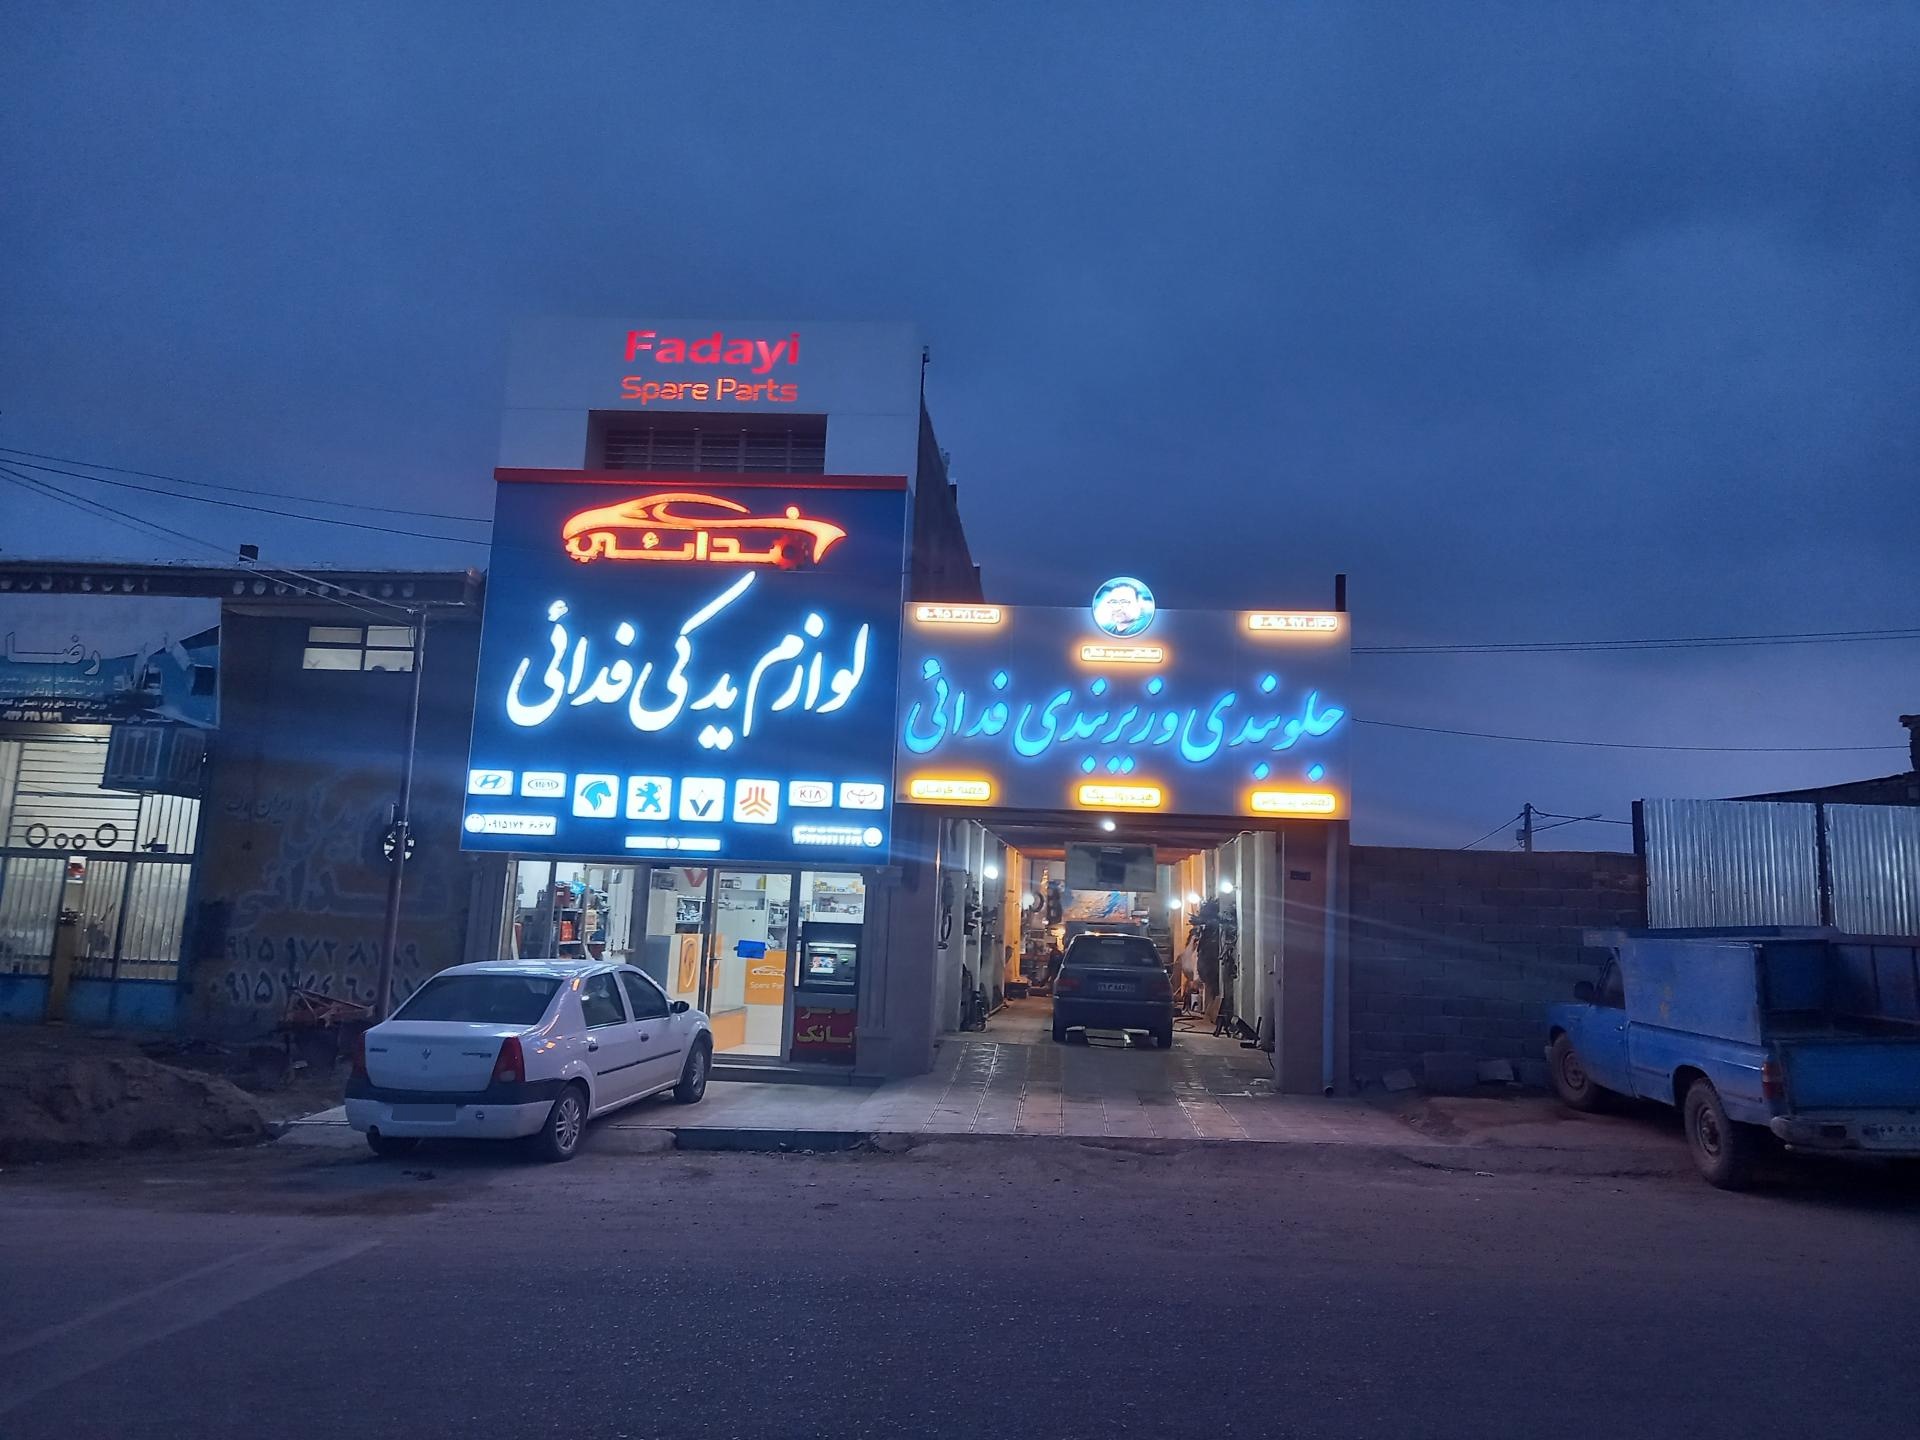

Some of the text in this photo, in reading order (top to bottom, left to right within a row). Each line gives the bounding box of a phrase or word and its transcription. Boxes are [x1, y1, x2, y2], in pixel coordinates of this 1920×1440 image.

[624, 330, 800, 374] Fadayi
[620, 375, 799, 406] Spare Parts
[5, 631, 101, 676] رضا
[628, 571, 756, 750] یدکی
[743, 612, 869, 737] لوازم
[796, 1025, 853, 1048] بانک
